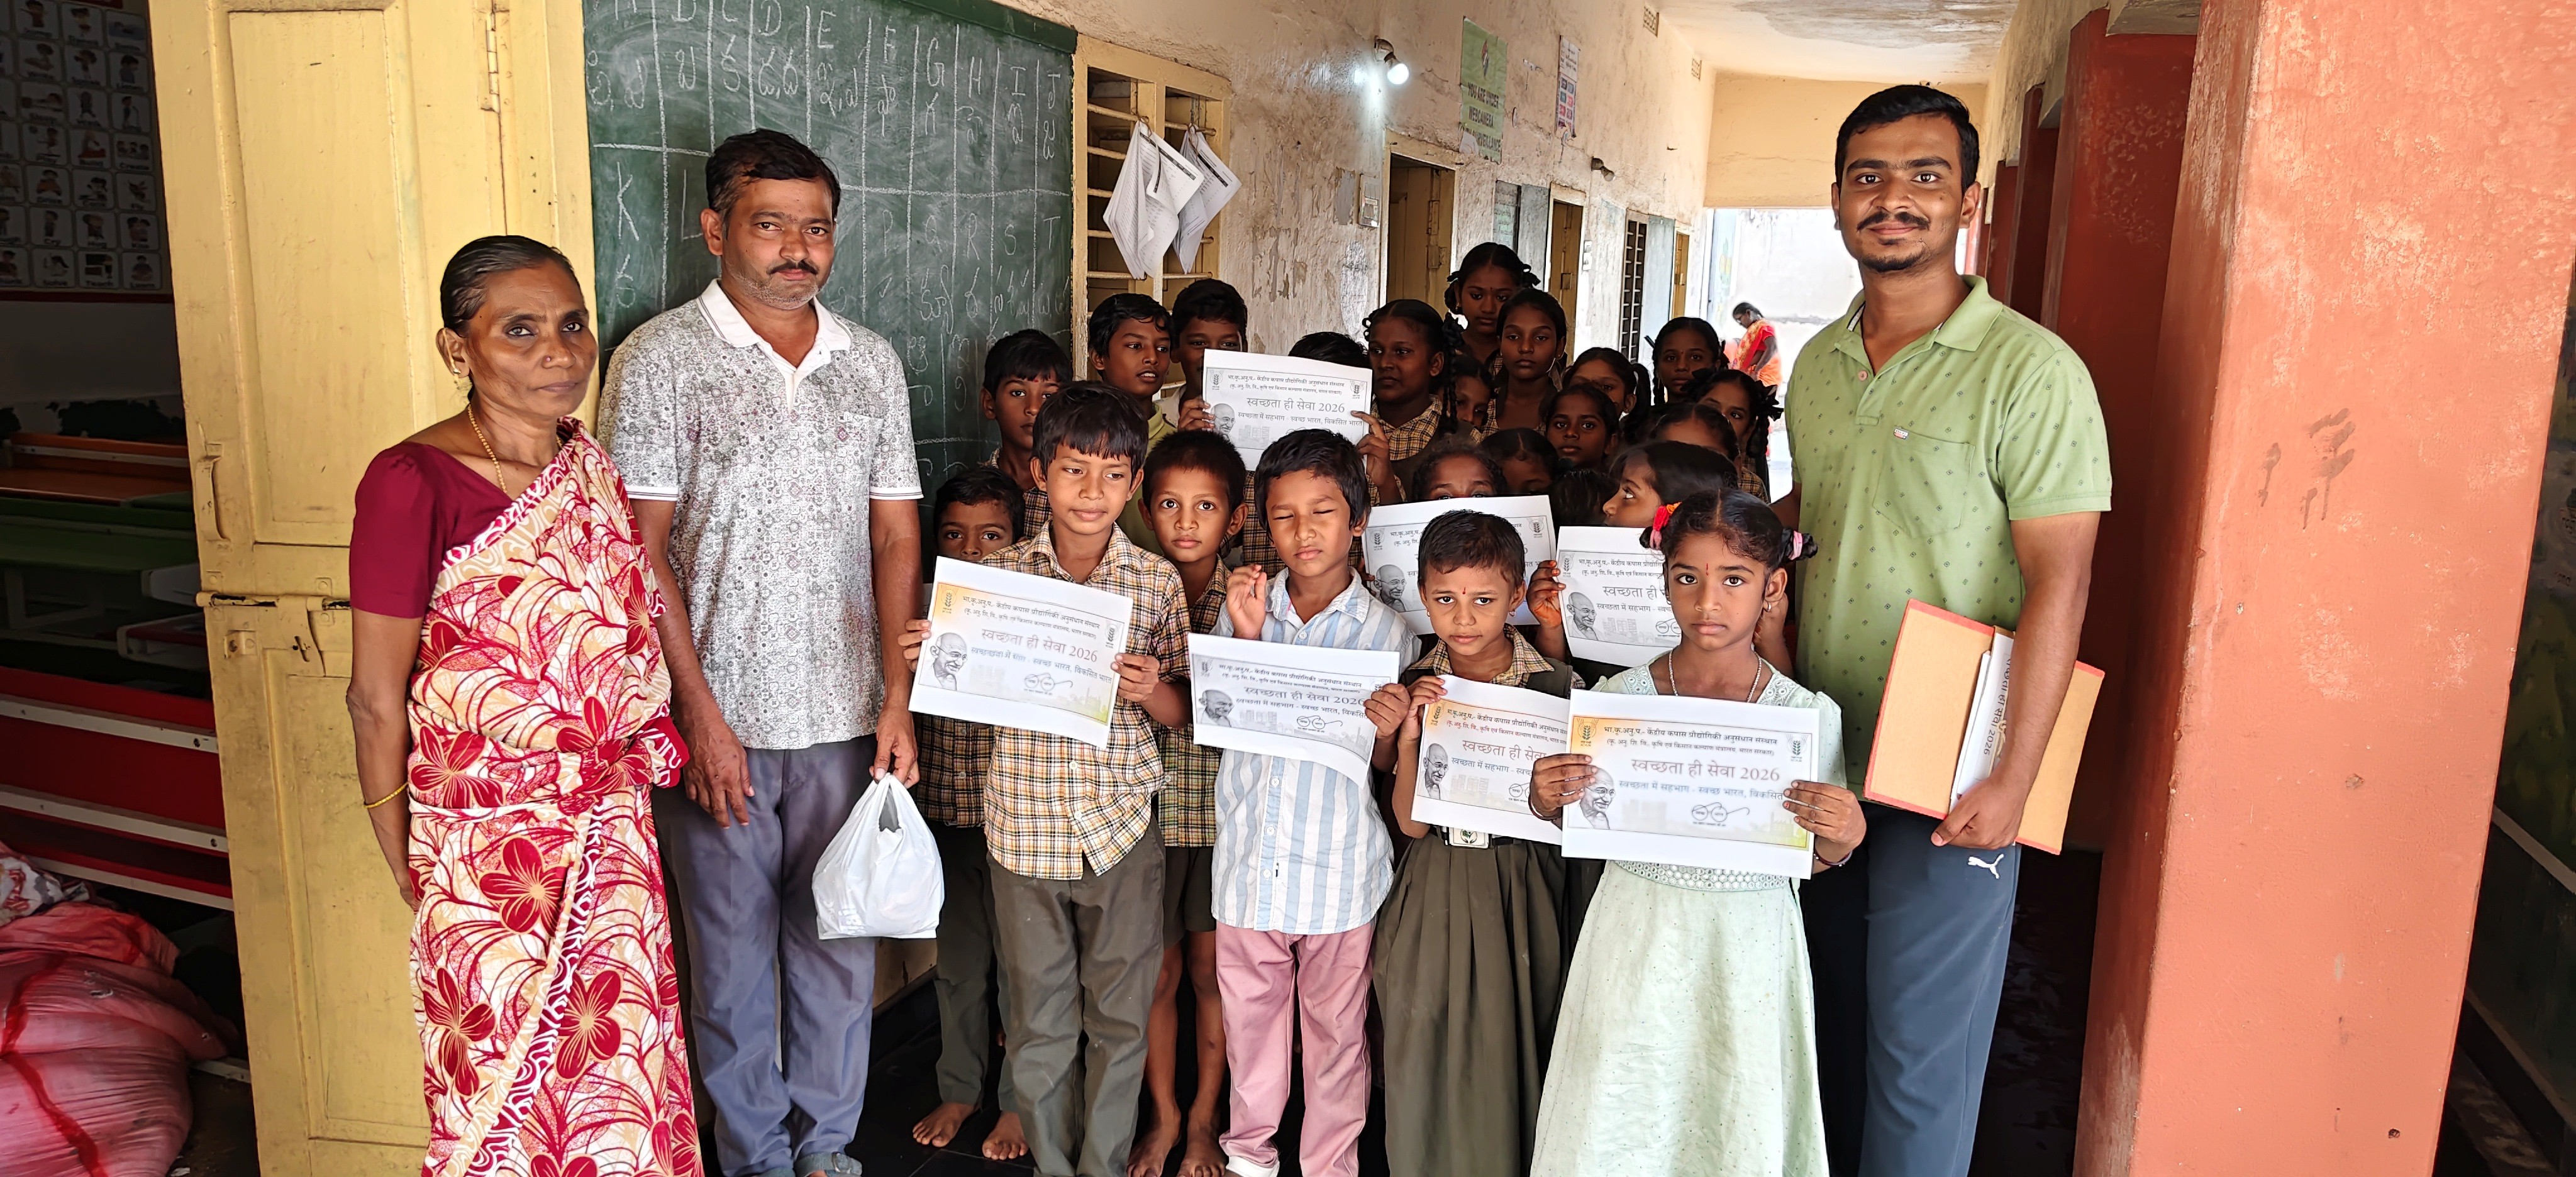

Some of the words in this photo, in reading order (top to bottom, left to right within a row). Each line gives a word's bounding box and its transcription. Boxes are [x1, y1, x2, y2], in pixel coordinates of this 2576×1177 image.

[758, 0, 782, 36] D
[818, 11, 837, 49] E
[884, 25, 896, 64] F
[926, 37, 945, 87] G
[968, 56, 983, 99] H
[1009, 66, 1027, 96] I
[1046, 74, 1061, 109] J
[1467, 82, 1477, 99] YOU
[616, 161, 640, 242] K
[680, 169, 704, 243] L
[882, 209, 894, 258] P
[923, 214, 943, 256] Q
[965, 212, 981, 261] R
[1003, 223, 1017, 257] S
[1043, 216, 1061, 250] T
[1246, 398, 1281, 408] स्वच्छता
[1284, 397, 1294, 410] ही
[1297, 398, 1316, 410] सेवा
[1319, 403, 1345, 412] 2026
[1602, 586, 1643, 597] स्वच्छता
[1646, 585, 1657, 600] ही
[982, 629, 1023, 645] स्वच्छता
[1027, 634, 1039, 649] ही
[1043, 636, 1067, 654] सेवा
[1069, 646, 1097, 662] 2026
[1075, 665, 1097, 678] विकसित
[1291, 691, 1302, 700] ही
[1306, 692, 1329, 702] सेवा
[1334, 697, 1365, 706] 2026
[1462, 740, 1506, 756] स्वच्छता
[1509, 744, 1521, 761] ही
[1984, 729, 1996, 756] 2026
[1452, 758, 1475, 767] स्वच्छता
[1485, 763, 1509, 772] सहभाग
[1631, 760, 1684, 775] स्वच्छता
[1688, 759, 1702, 778] ही
[1707, 760, 1736, 778] सेवा
[1740, 767, 1780, 782] 2026
[1619, 780, 1649, 790] स्वच्छता
[1660, 783, 1689, 793] सहभाग
[1699, 787, 1720, 795] स्वच्छ
[1724, 788, 1746, 798] भारत,
[1750, 788, 1784, 800] विकसित
